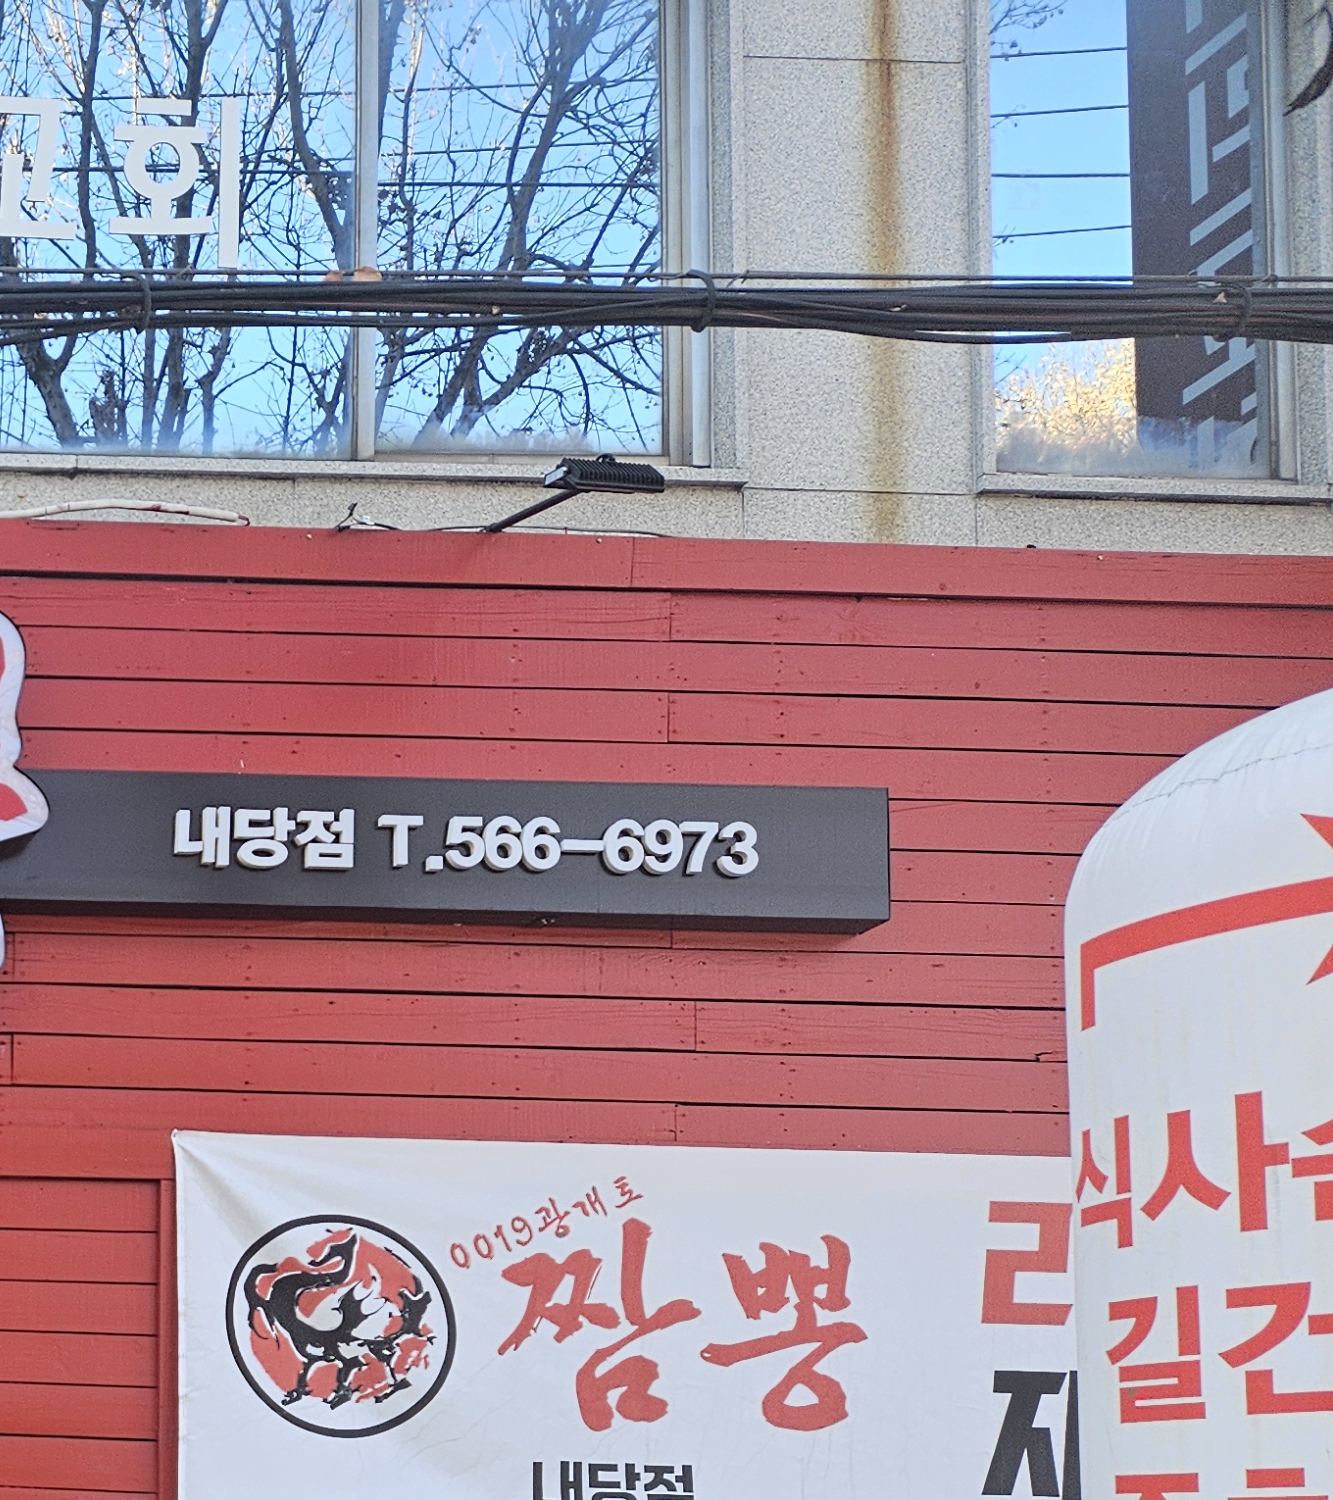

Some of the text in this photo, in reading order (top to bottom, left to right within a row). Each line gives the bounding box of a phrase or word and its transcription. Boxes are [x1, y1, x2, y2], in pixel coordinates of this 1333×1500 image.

[174, 806, 760, 877] 내당점 T.566-6973
[451, 1175, 644, 1270] 0019광개토
